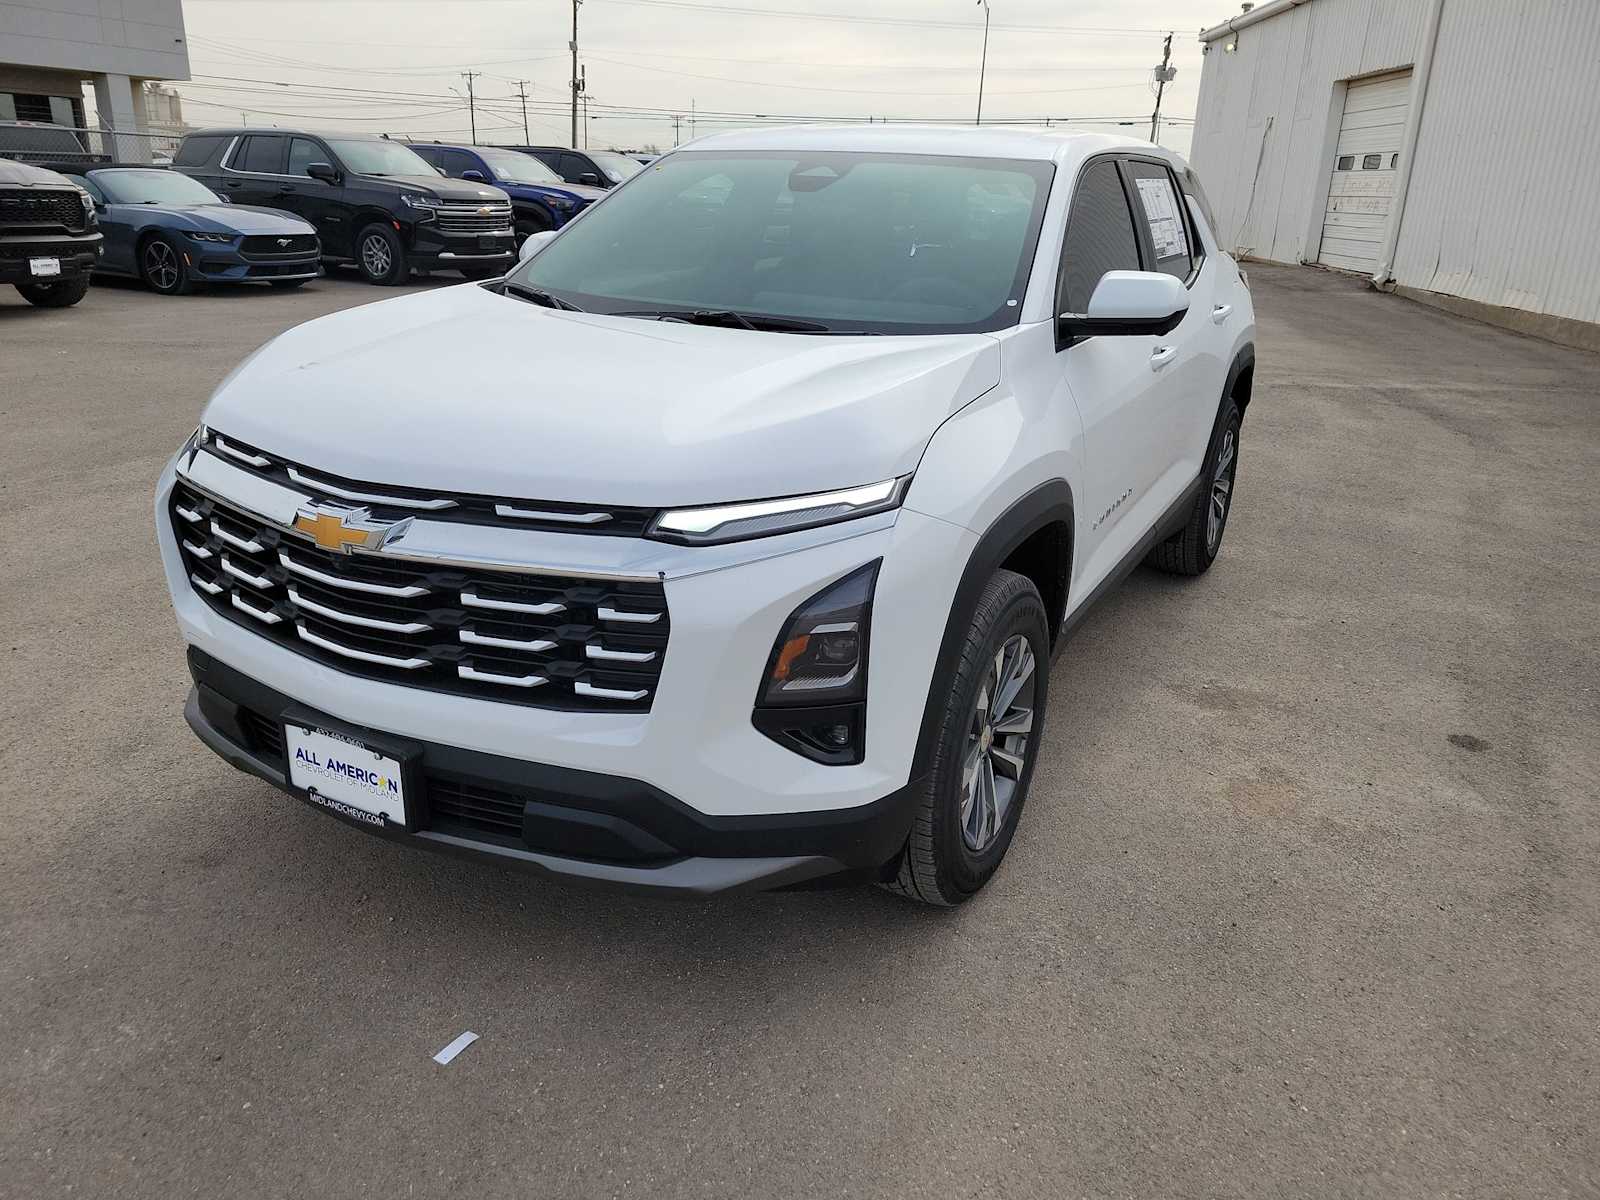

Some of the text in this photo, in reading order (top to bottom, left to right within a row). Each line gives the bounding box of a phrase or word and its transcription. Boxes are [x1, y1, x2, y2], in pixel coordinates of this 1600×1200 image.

[296, 747, 398, 793] ALL AMERICN
[296, 761, 344, 782] CHEVROLET
[309, 793, 385, 827] MIDLANDCHEVY.COM
